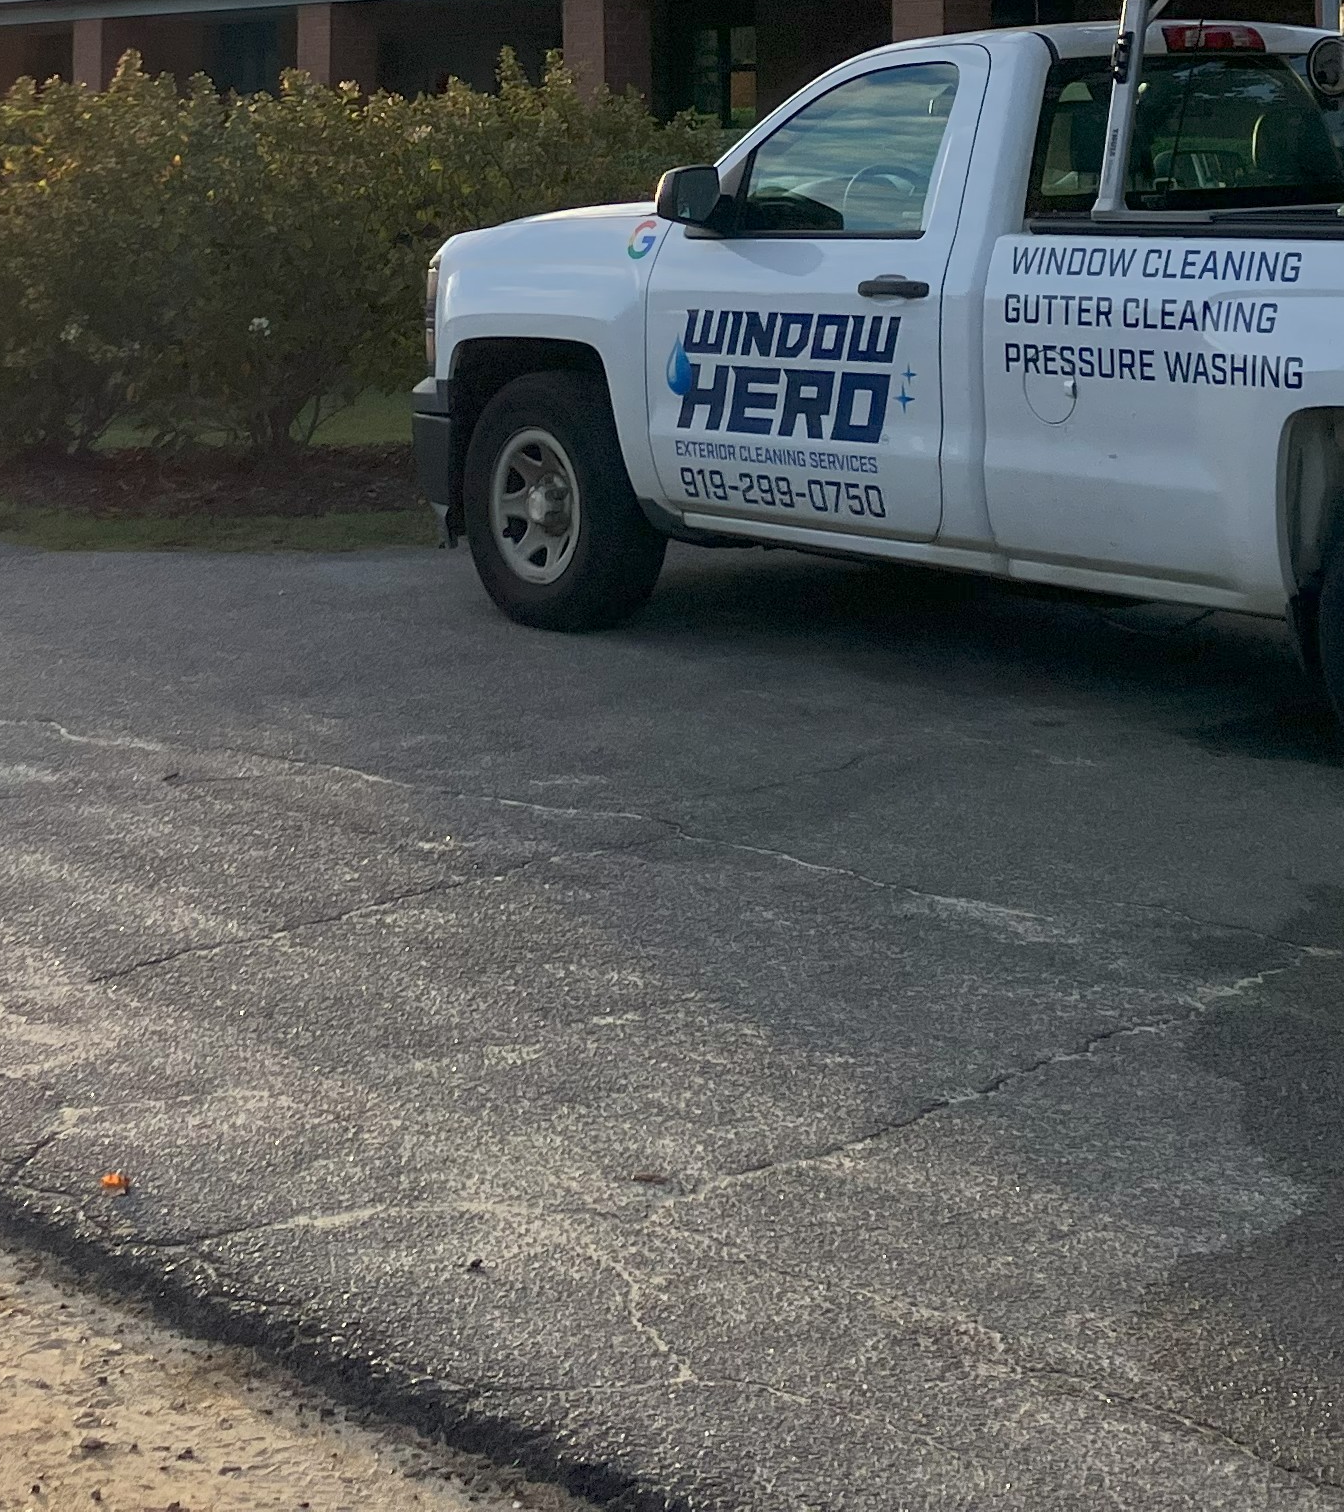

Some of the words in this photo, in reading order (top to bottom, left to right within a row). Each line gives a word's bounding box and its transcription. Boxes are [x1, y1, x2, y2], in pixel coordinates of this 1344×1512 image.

[628, 220, 657, 259] G
[1012, 246, 1137, 277] WINDOW
[1142, 249, 1302, 283] CLEANING
[1005, 294, 1112, 327] GUTTER
[1123, 298, 1278, 333] CLEANING
[683, 309, 902, 363] WINDOW
[1005, 343, 1155, 381] PRESSURE
[1163, 351, 1304, 389] WASHING
[677, 363, 891, 444] HERO
[675, 440, 736, 461] EXTERIOR
[739, 447, 806, 467] CLEANING
[809, 452, 878, 474] SERVICES
[680, 467, 886, 517] 919-299-0750
